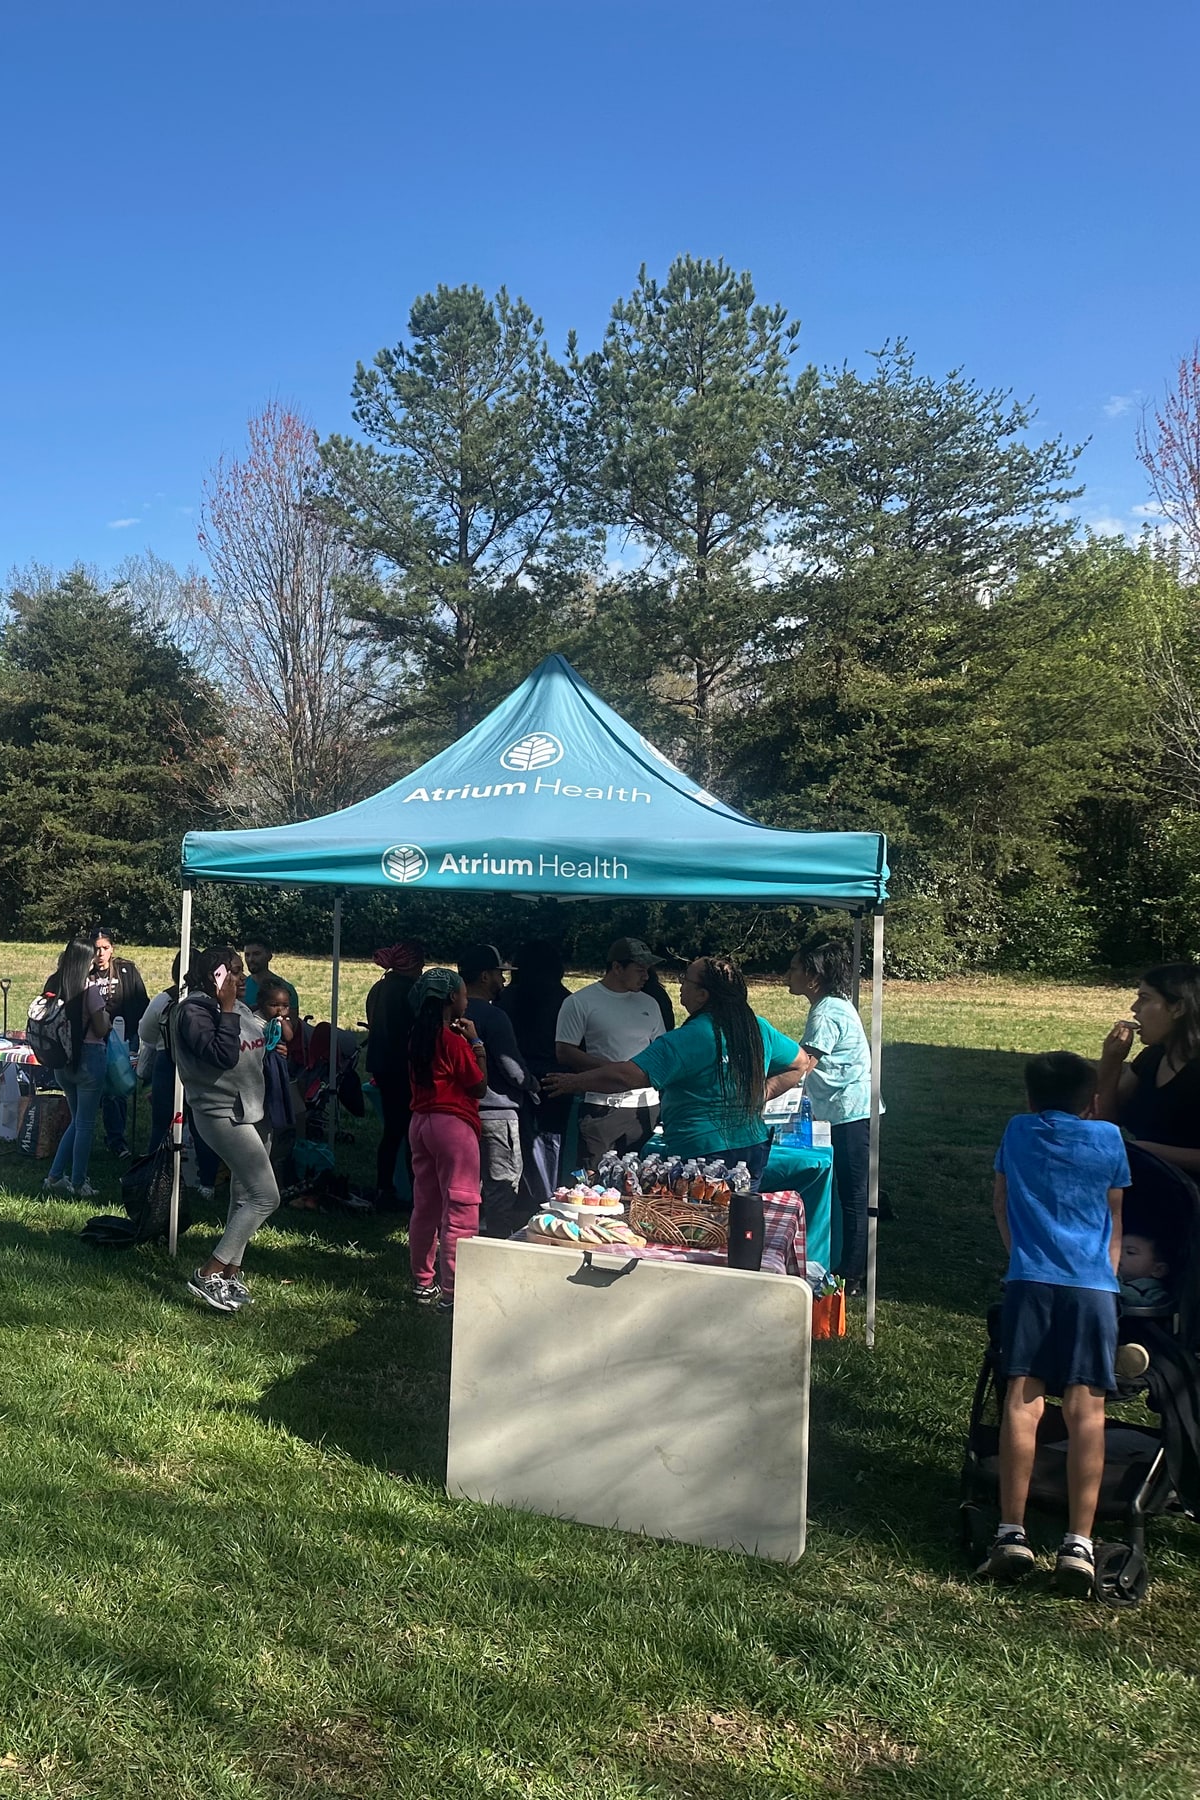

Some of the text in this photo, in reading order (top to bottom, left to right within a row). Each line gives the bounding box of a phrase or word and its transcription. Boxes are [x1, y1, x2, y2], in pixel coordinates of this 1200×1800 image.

[402, 779, 526, 804] Atrium
[533, 776, 652, 804] Health
[437, 852, 629, 880] Atrium Health
[21, 1105, 37, 1153] Marshalls
